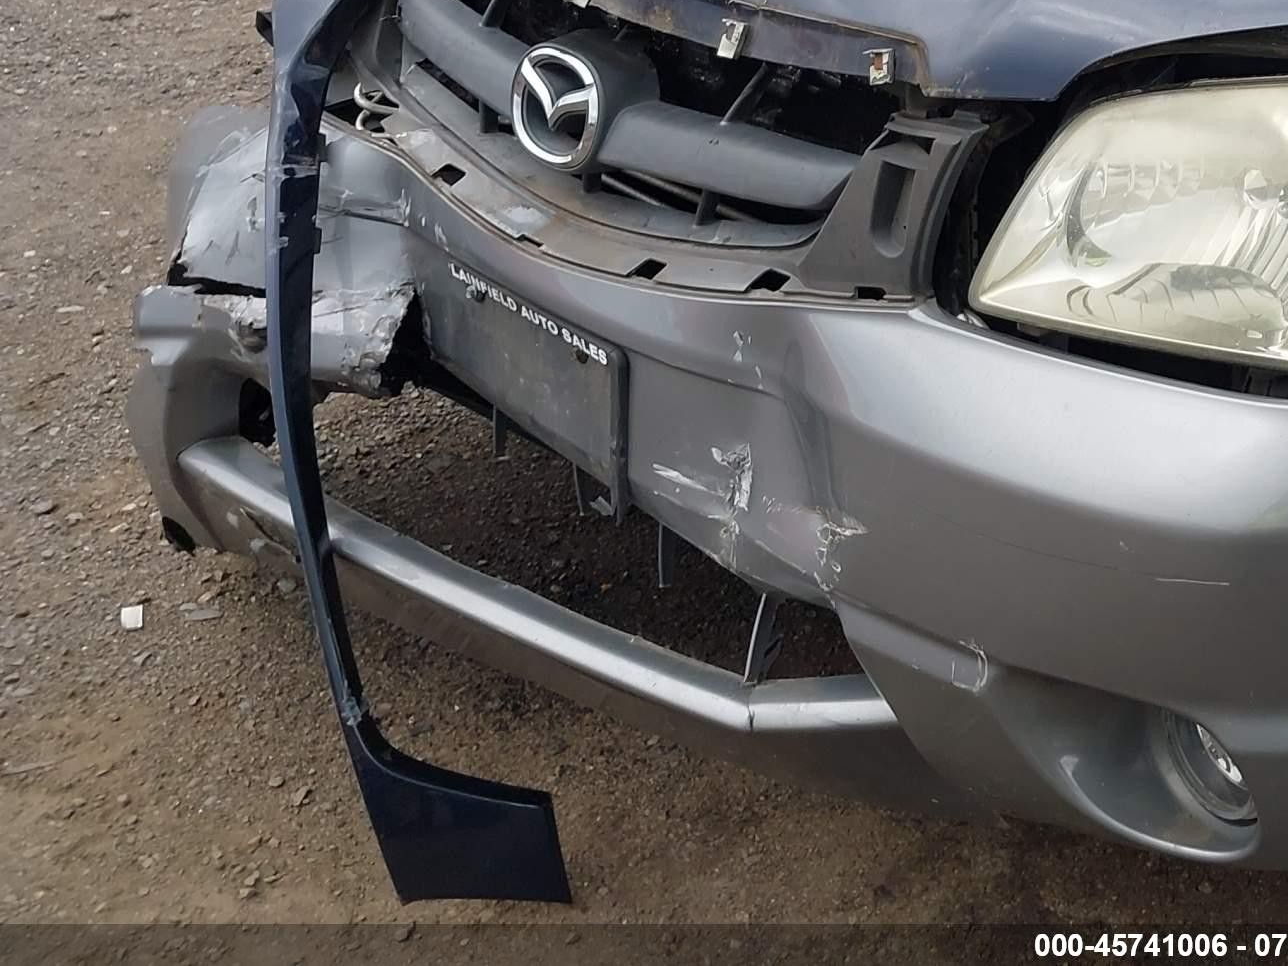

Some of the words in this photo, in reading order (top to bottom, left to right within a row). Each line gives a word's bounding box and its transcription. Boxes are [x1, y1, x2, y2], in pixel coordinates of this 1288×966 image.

[448, 262, 517, 312] LAINFIELD
[521, 305, 559, 336] AUTO
[561, 328, 608, 366] SALES
